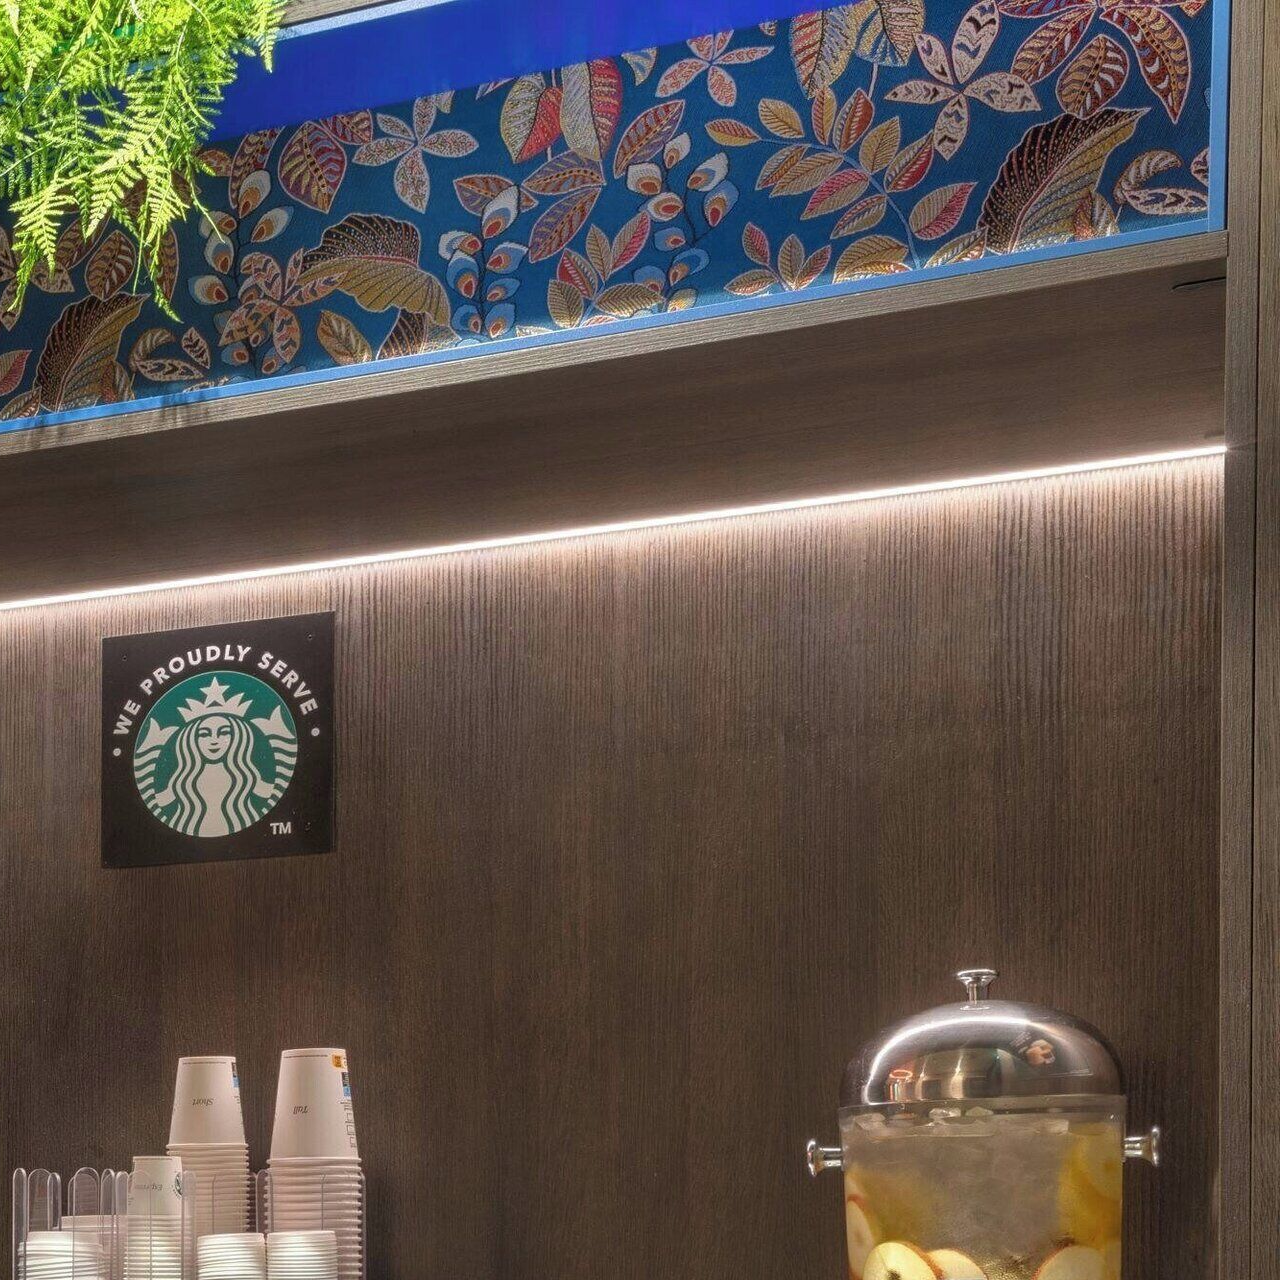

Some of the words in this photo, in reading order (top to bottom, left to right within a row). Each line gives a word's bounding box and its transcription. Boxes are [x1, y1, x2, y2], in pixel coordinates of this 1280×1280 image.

[113, 700, 141, 736] WE
[140, 644, 251, 696] PROUDLY
[257, 652, 320, 715] SERVE
[269, 822, 292, 835] TM
[192, 1098, 214, 1106] Short
[293, 1105, 309, 1115] Tall
